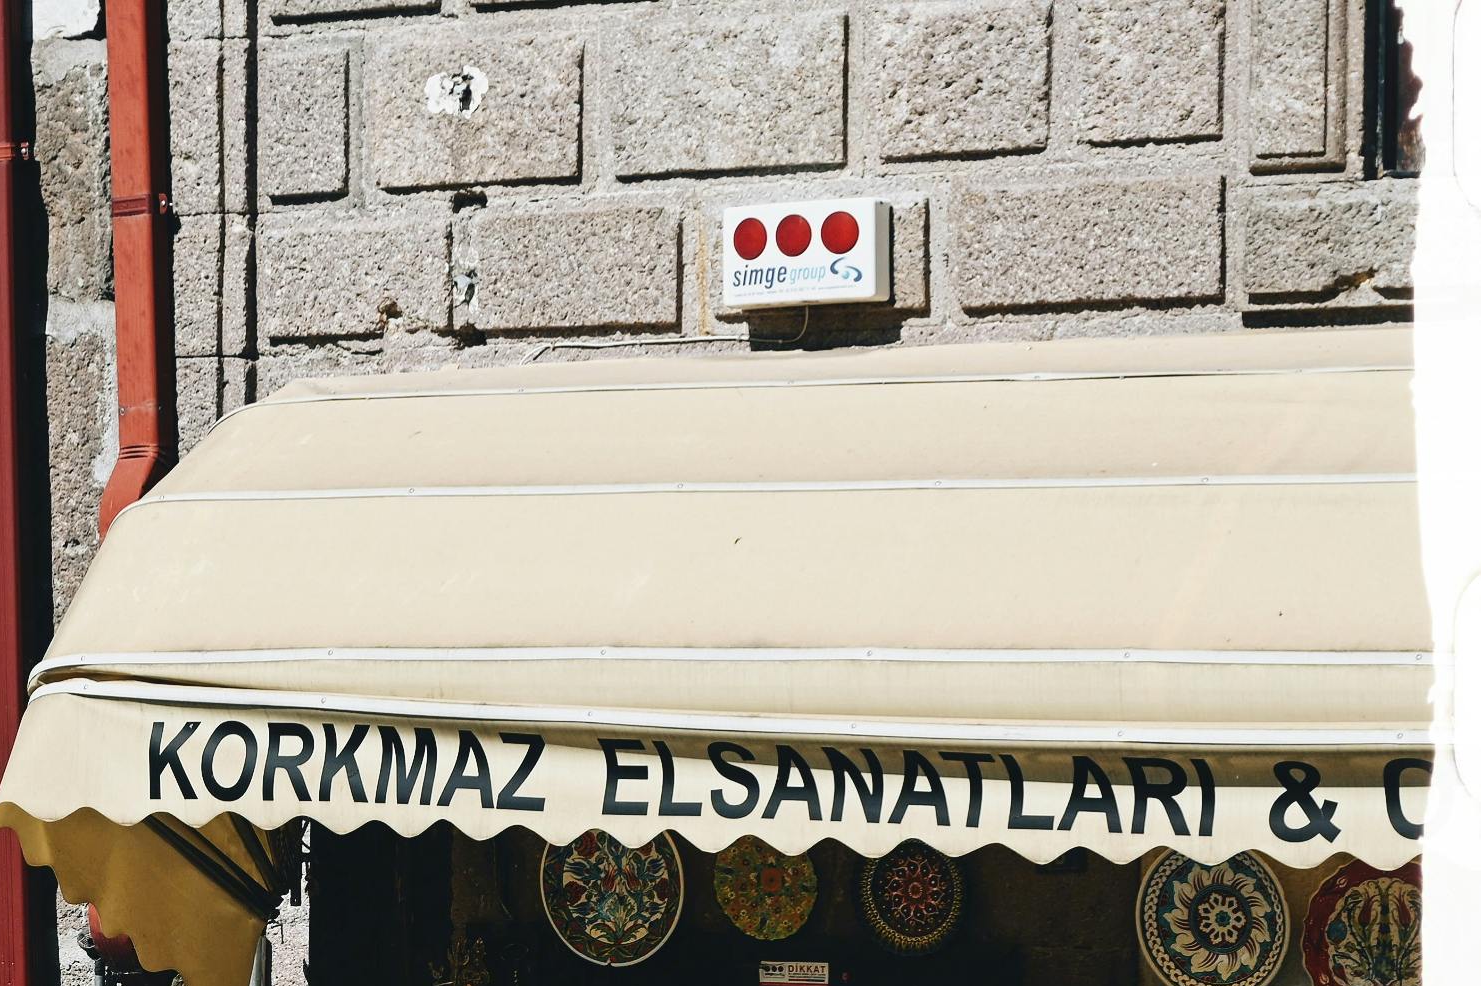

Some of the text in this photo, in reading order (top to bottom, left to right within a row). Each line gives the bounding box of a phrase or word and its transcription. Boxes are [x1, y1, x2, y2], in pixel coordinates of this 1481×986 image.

[733, 265, 825, 289] simge group
[149, 720, 546, 811] KORKMAZ
[598, 738, 1216, 837] ELSANATLARI
[1269, 760, 1342, 843] &
[788, 963, 826, 973] DİKKAT
